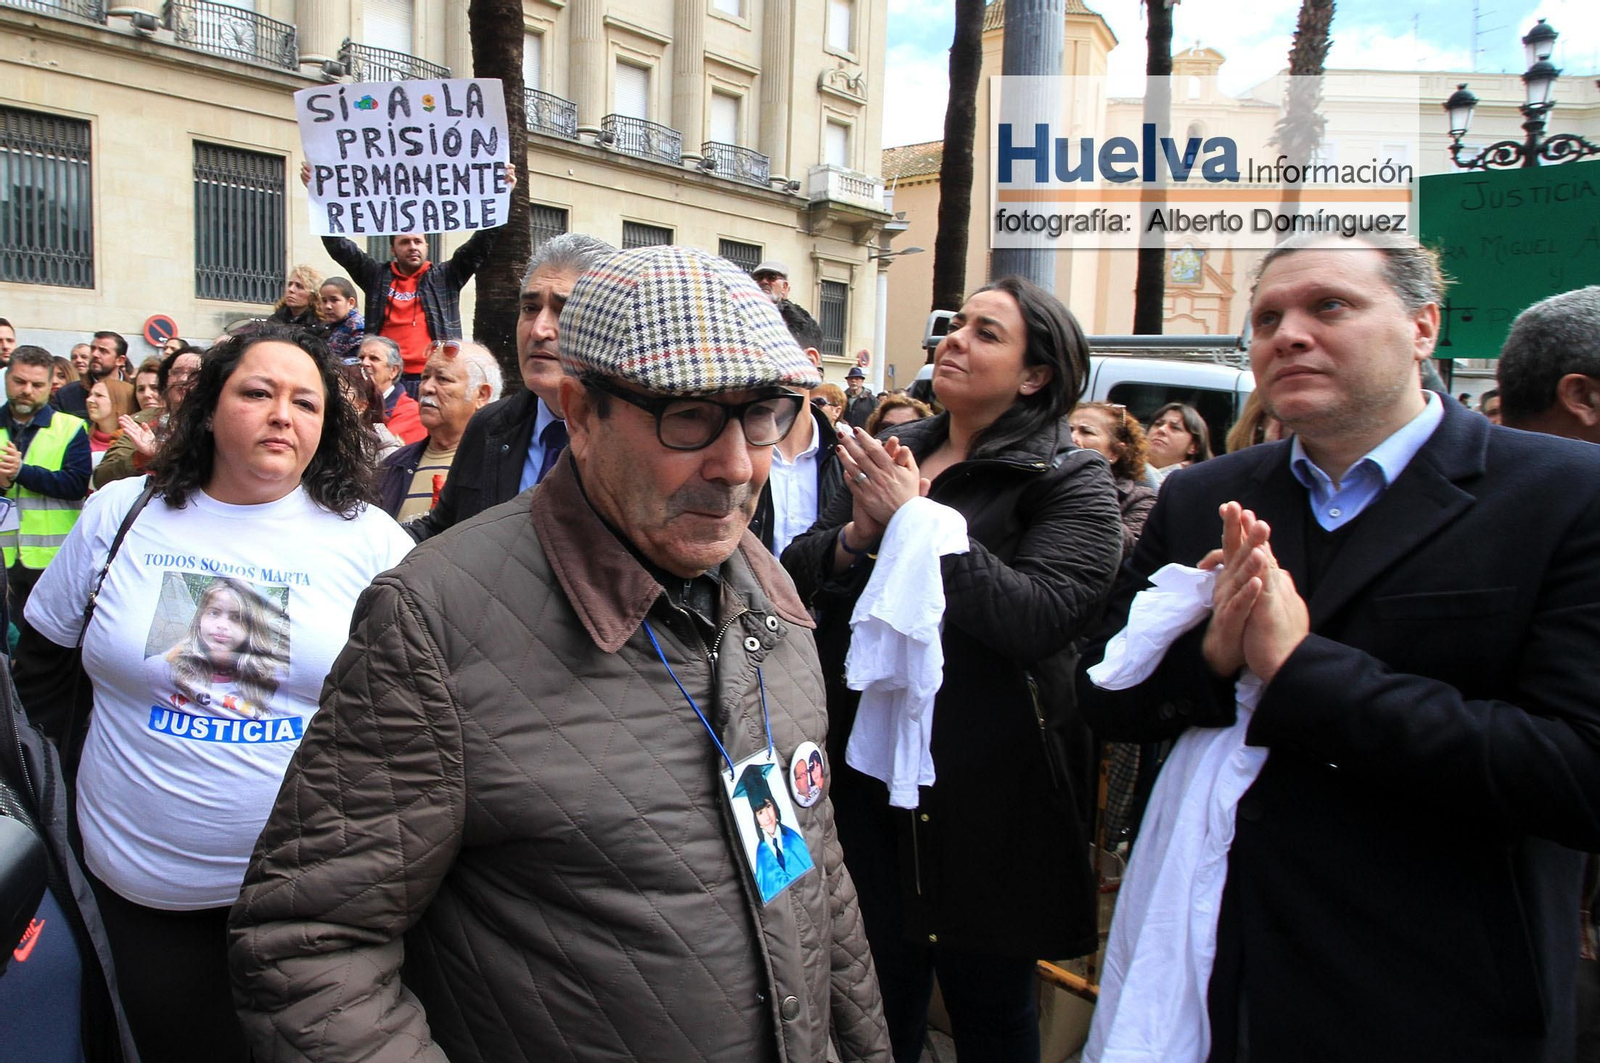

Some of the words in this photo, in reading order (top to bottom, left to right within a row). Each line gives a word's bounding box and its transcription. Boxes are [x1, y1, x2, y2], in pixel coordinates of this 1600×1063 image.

[388, 86, 411, 120] A
[442, 83, 484, 118] LA
[315, 162, 507, 197] PERMANENTE
[144, 553, 196, 569] TODOS
[200, 557, 256, 578] SOMOS
[260, 568, 311, 586] MARTA
[154, 711, 296, 742] JUSTICIA
